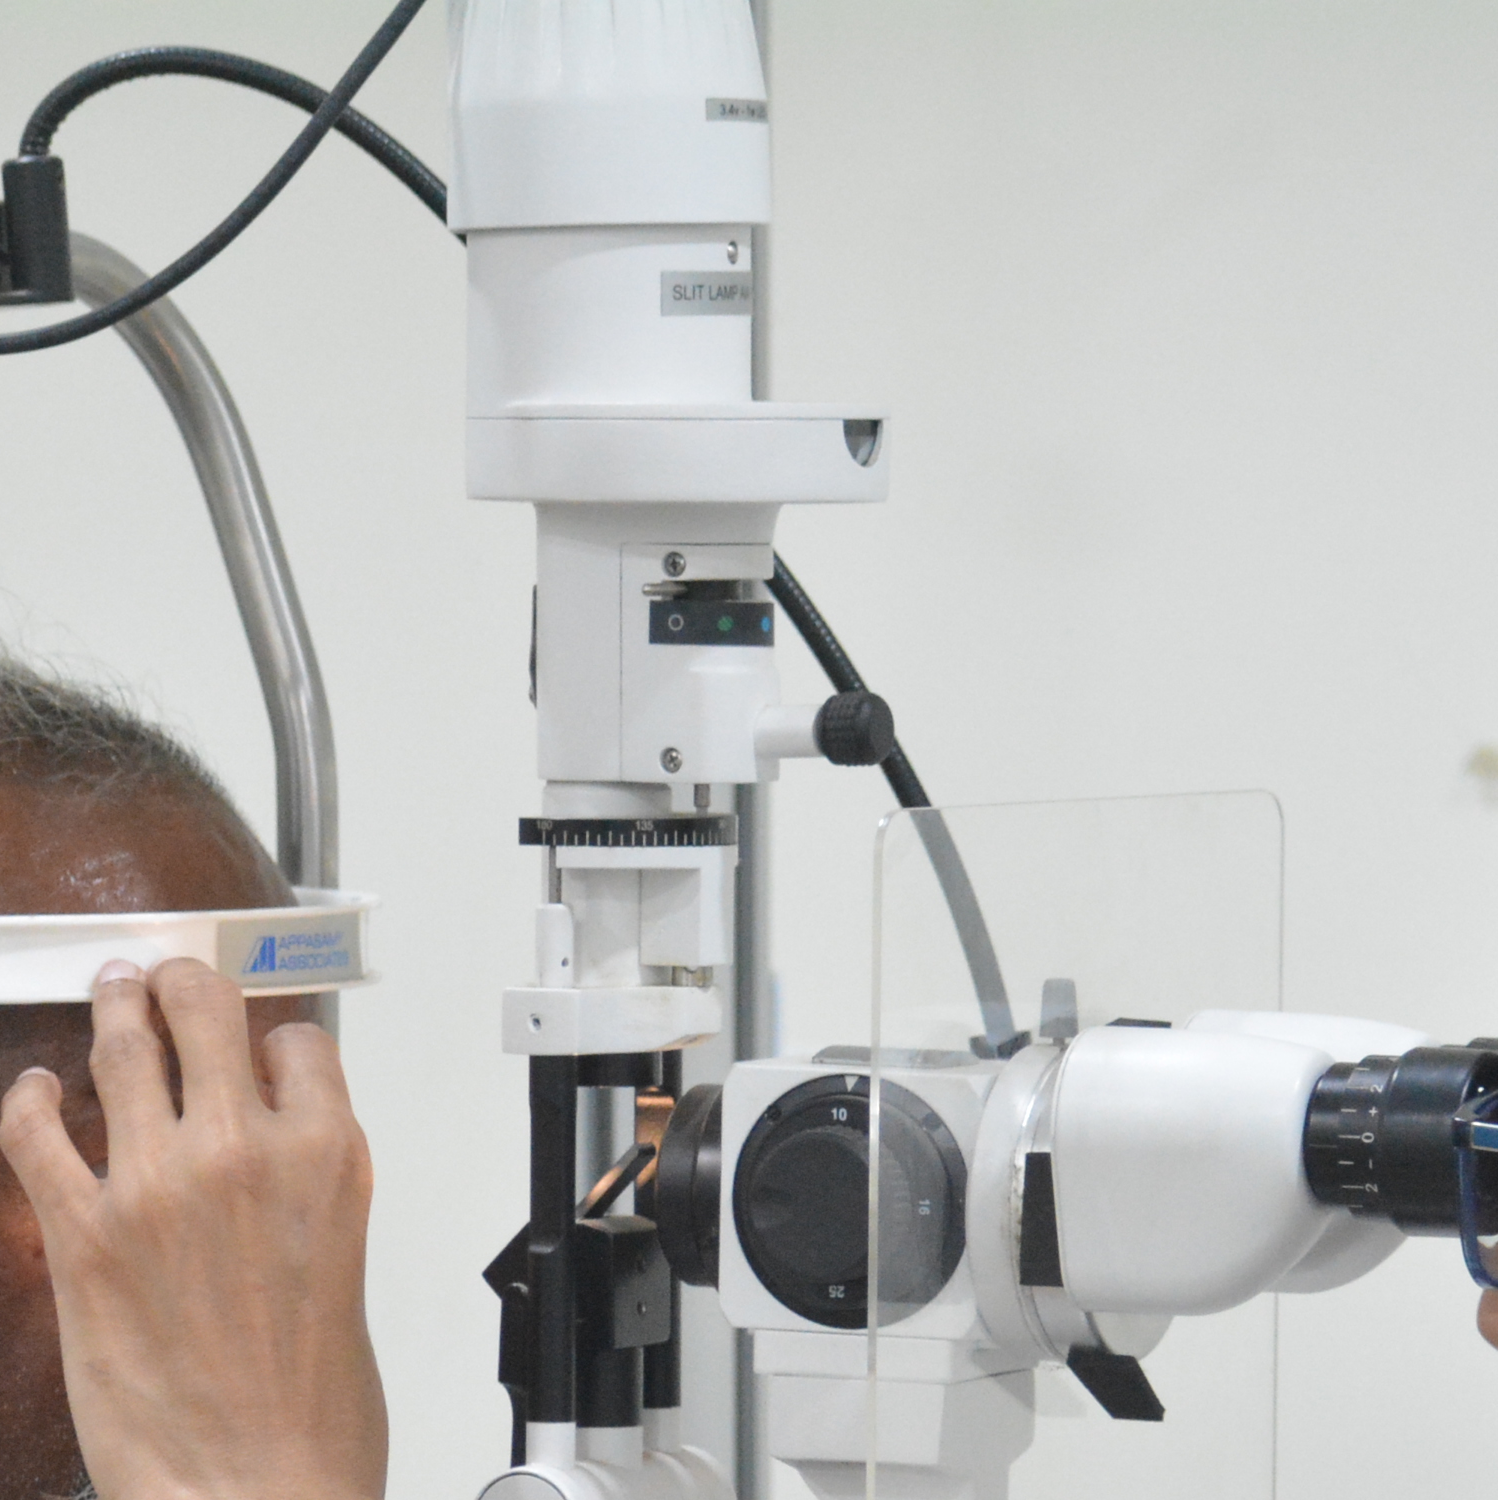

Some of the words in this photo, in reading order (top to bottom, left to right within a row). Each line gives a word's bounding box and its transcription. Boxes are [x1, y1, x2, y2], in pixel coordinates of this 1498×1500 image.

[672, 284, 705, 301] SLIT
[708, 284, 738, 301] LAMP
[635, 820, 654, 831] 135
[1370, 1084, 1383, 1093] 2
[830, 1107, 848, 1121] 10
[1361, 1132, 1374, 1143] 0
[1365, 1183, 1378, 1193] 2
[918, 1199, 931, 1216] 16
[828, 1285, 845, 1299] 25
